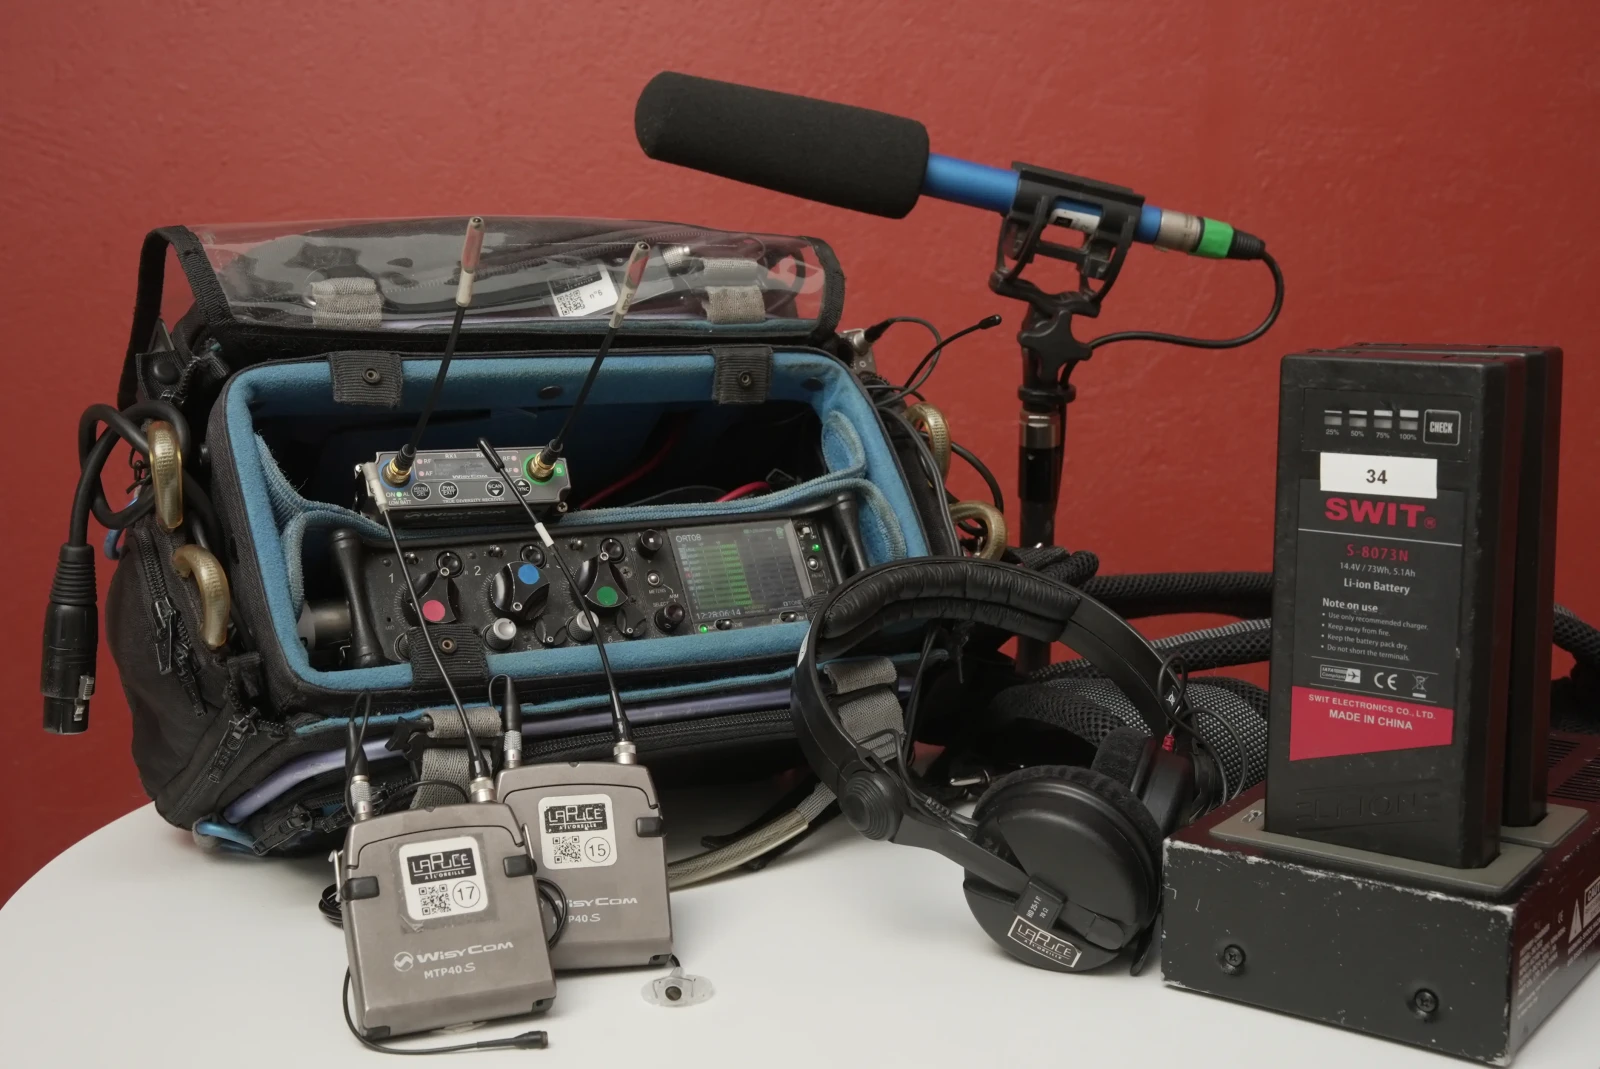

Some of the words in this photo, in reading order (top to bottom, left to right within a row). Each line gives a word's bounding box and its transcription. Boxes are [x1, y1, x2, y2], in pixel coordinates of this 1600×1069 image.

[1350, 430, 1364, 438] 50%
[1429, 421, 1454, 434] CHECK
[1366, 468, 1388, 484] 34
[1324, 497, 1426, 528] SWIT
[1346, 544, 1409, 562] S-8073N
[388, 572, 394, 584] 1
[474, 566, 482, 576] 2
[1340, 562, 1360, 572] 14.4V
[1368, 564, 1392, 576] 73Wh,
[1393, 568, 1416, 578] 5.1Ah
[1344, 578, 1371, 590] Li-ion
[1374, 581, 1410, 596] Battery
[1322, 597, 1345, 608] Note
[1346, 602, 1359, 610] on
[1362, 604, 1378, 612] use
[1328, 622, 1344, 632] Keep
[1344, 626, 1361, 634] away
[1362, 626, 1377, 635] from
[1340, 614, 1354, 622] only
[1356, 616, 1402, 627] recommended
[1402, 621, 1429, 631] charger.
[1327, 634, 1344, 642] Keep
[1356, 637, 1379, 647] battery
[1380, 641, 1396, 649] pack
[1396, 642, 1409, 650] dry.
[1349, 646, 1366, 656] short
[1378, 652, 1410, 662] terminals.
[1308, 694, 1330, 703] SWIT
[1332, 698, 1394, 713] ELECTRONICS
[1416, 710, 1436, 720] LTD.
[1329, 709, 1360, 722] MADE
[1364, 714, 1374, 724] IN
[1378, 717, 1412, 730] CHINA
[588, 844, 606, 856] 15
[457, 886, 474, 900] 17
